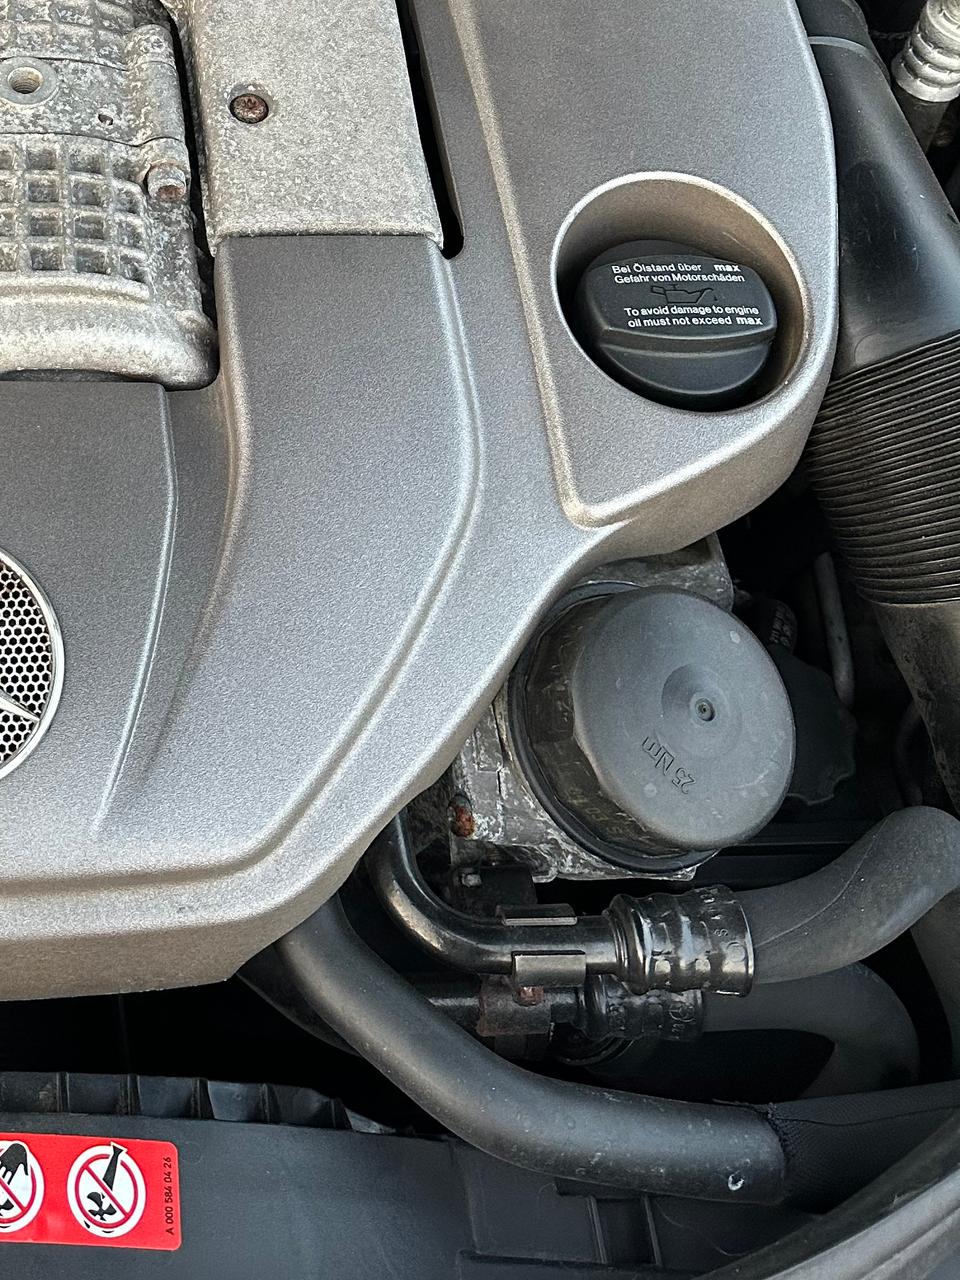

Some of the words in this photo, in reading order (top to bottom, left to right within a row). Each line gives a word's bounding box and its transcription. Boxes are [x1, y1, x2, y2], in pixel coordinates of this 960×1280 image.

[611, 265, 631, 274] Bei
[633, 262, 676, 272] Ölstand
[677, 263, 701, 271] über
[713, 264, 741, 272] max
[614, 274, 650, 284] Gefahr
[671, 273, 745, 282] Motorschäden
[623, 307, 640, 317] To
[640, 306, 670, 315] avoid
[670, 305, 712, 315] damage
[712, 305, 723, 314] to
[724, 306, 759, 316] engine
[627, 318, 642, 328] oil
[642, 317, 672, 327] must
[672, 316, 691, 325] not
[691, 316, 733, 325] exceed
[736, 317, 763, 326] max
[641, 736, 675, 777] Nm
[671, 767, 696, 795] 25
[163, 1156, 172, 1169] 26
[163, 1171, 172, 1183] 04
[164, 1185, 173, 1204] 584
[165, 1206, 174, 1225] 000
[165, 1227, 175, 1236] A
